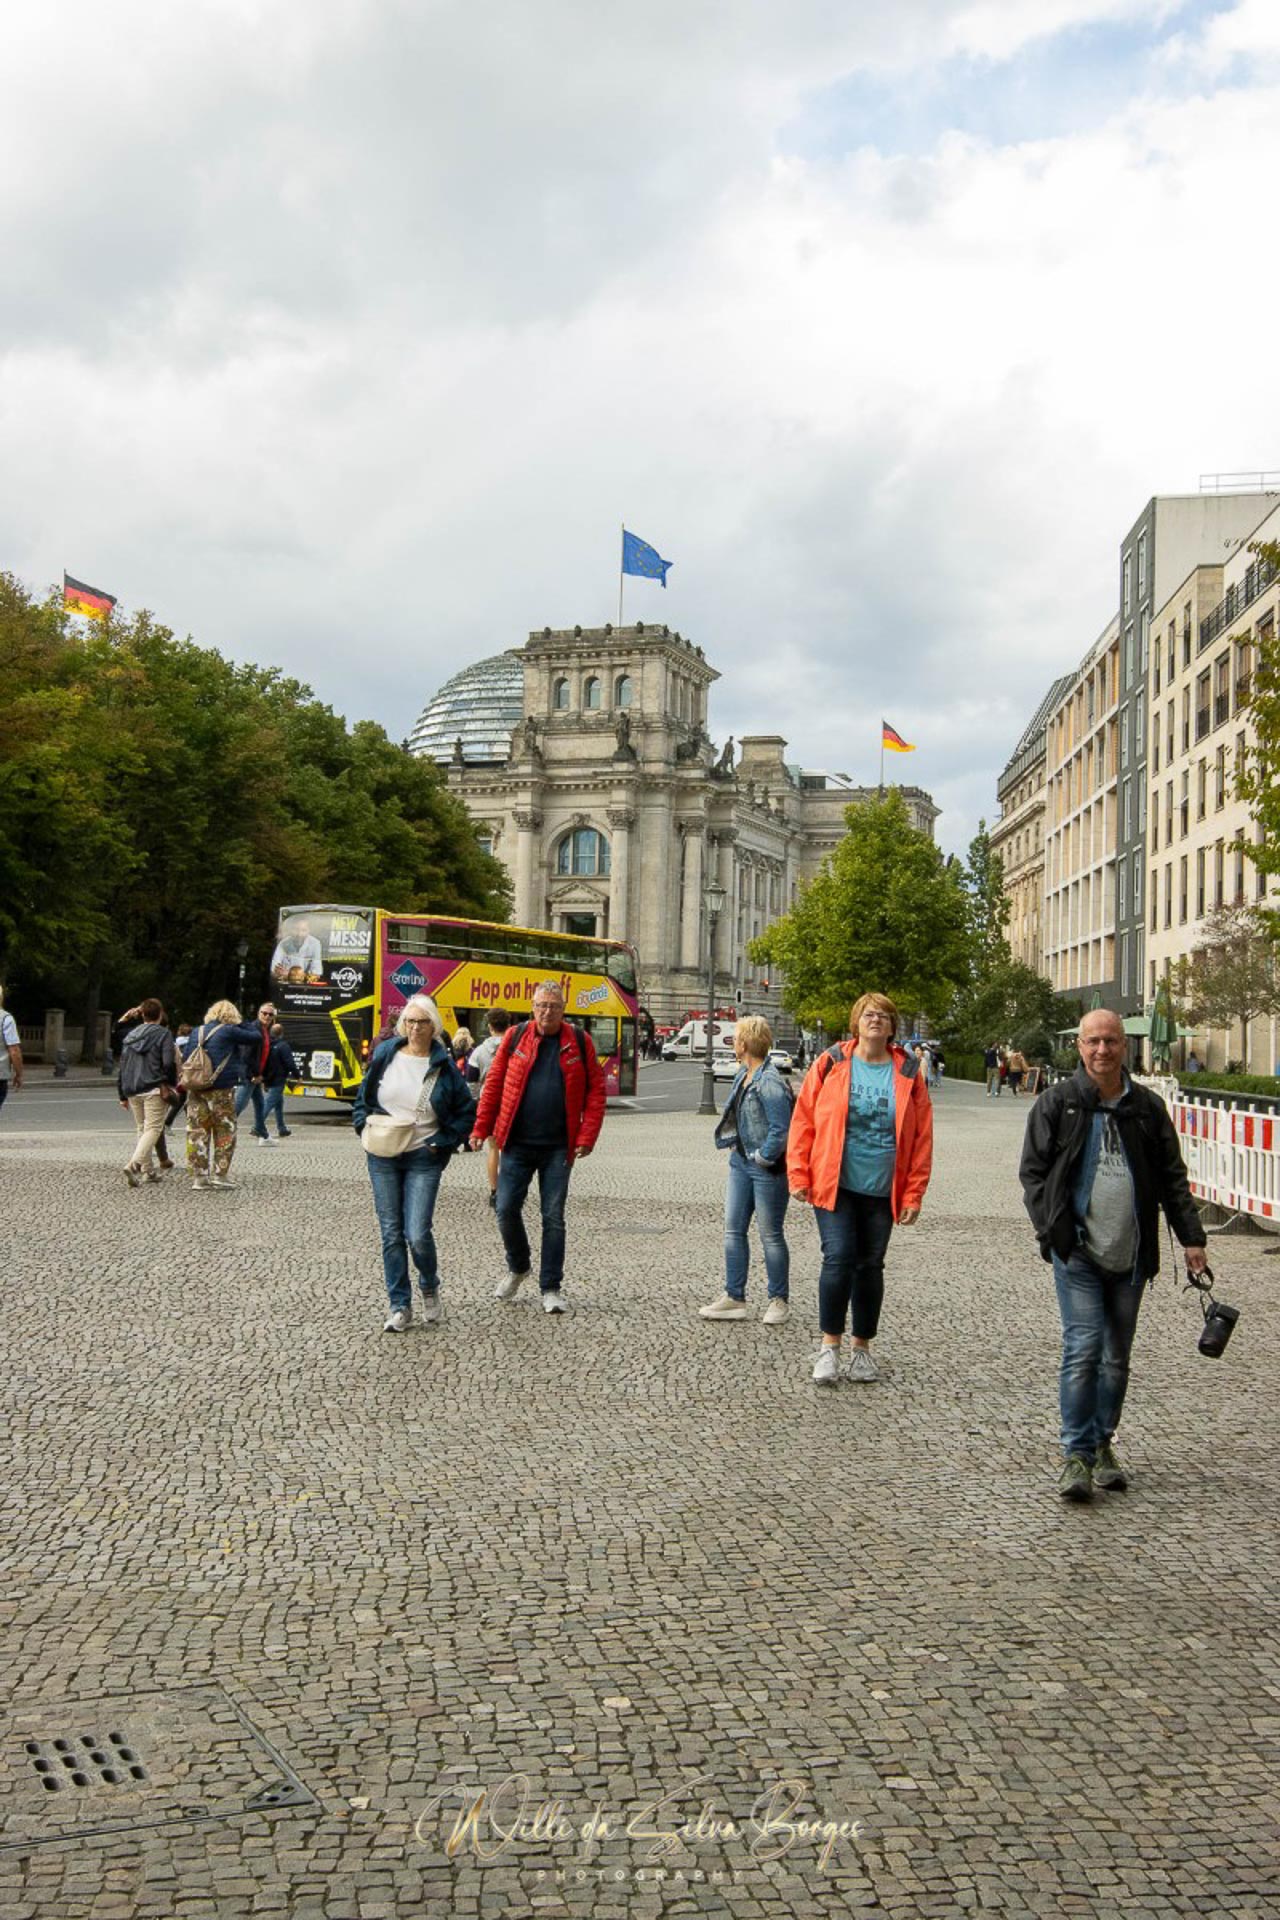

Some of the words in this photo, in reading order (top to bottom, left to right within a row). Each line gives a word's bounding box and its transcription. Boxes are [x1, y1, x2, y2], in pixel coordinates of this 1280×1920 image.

[331, 916, 359, 931] NEW
[329, 930, 371, 947] MESSI
[470, 977, 499, 1006] Hop
[503, 979, 521, 1000] on
[524, 977, 540, 1001] ho
[560, 973, 572, 1003] ff
